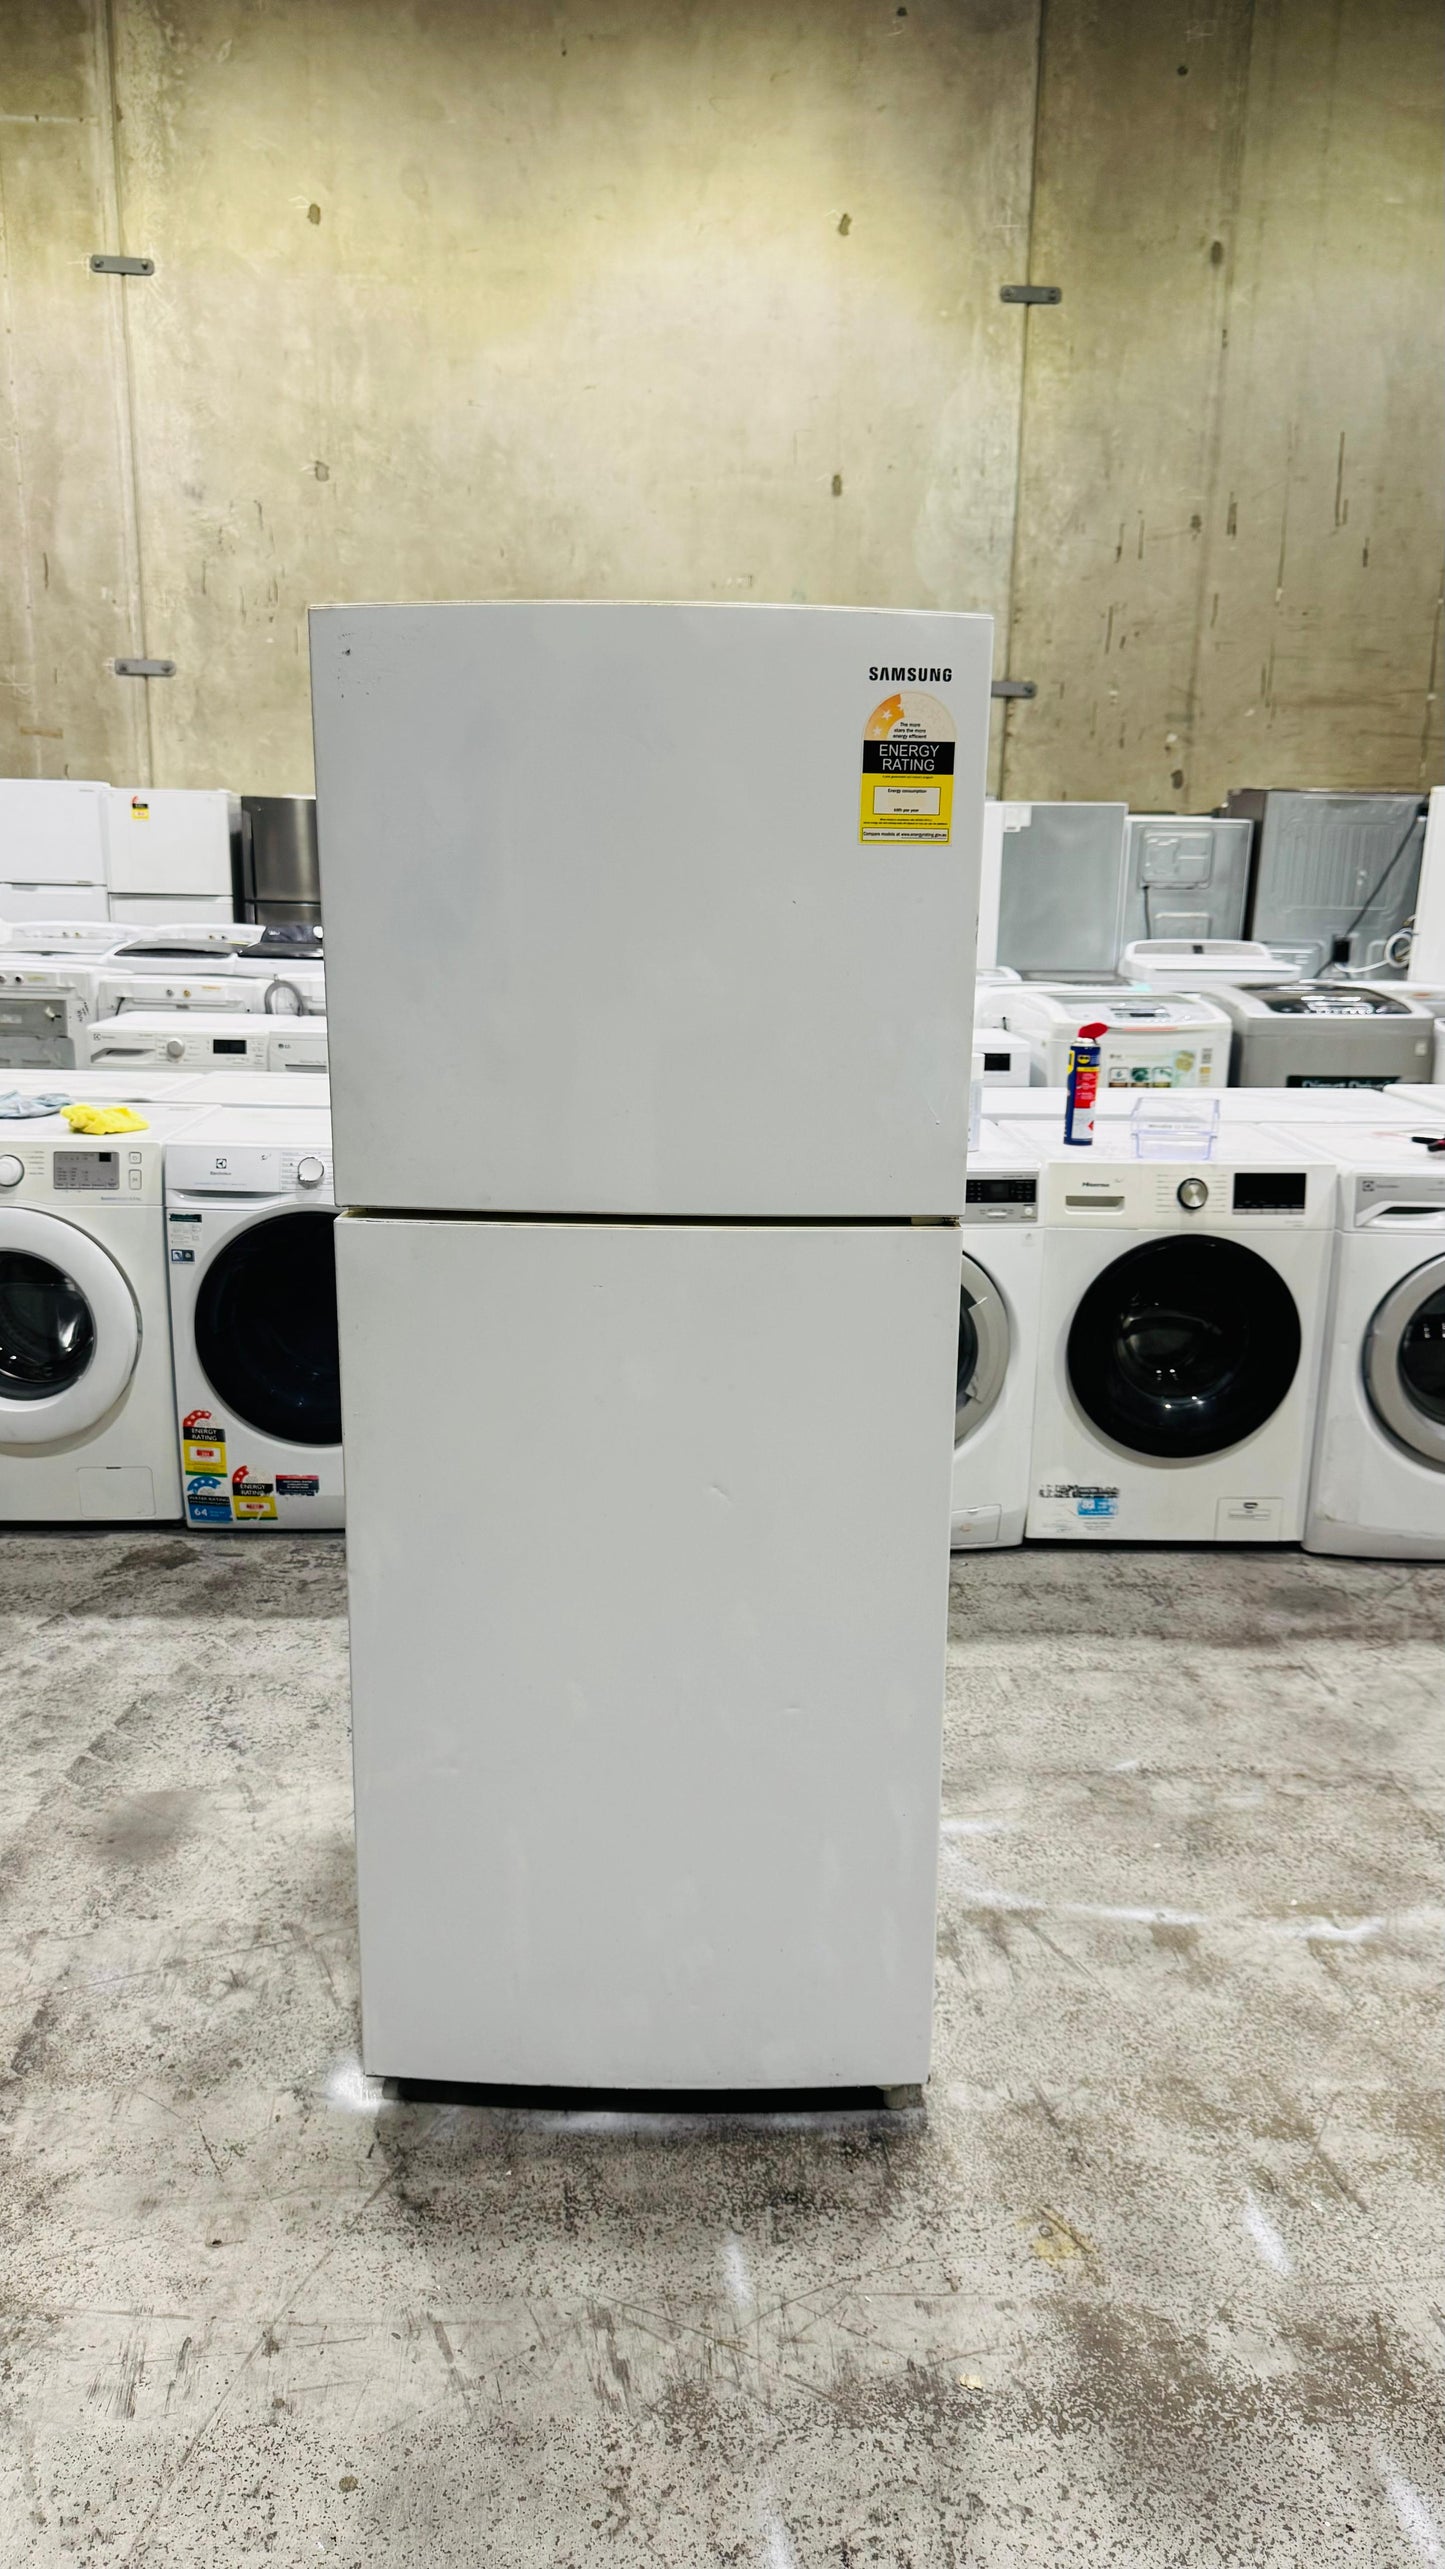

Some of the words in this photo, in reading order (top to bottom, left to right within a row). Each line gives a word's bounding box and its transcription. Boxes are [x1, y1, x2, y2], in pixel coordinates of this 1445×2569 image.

[868, 666, 953, 682] SAMSUNG
[879, 743, 940, 757] ENERGY
[882, 758, 935, 772] RATING
[194, 1508, 208, 1517] 64
